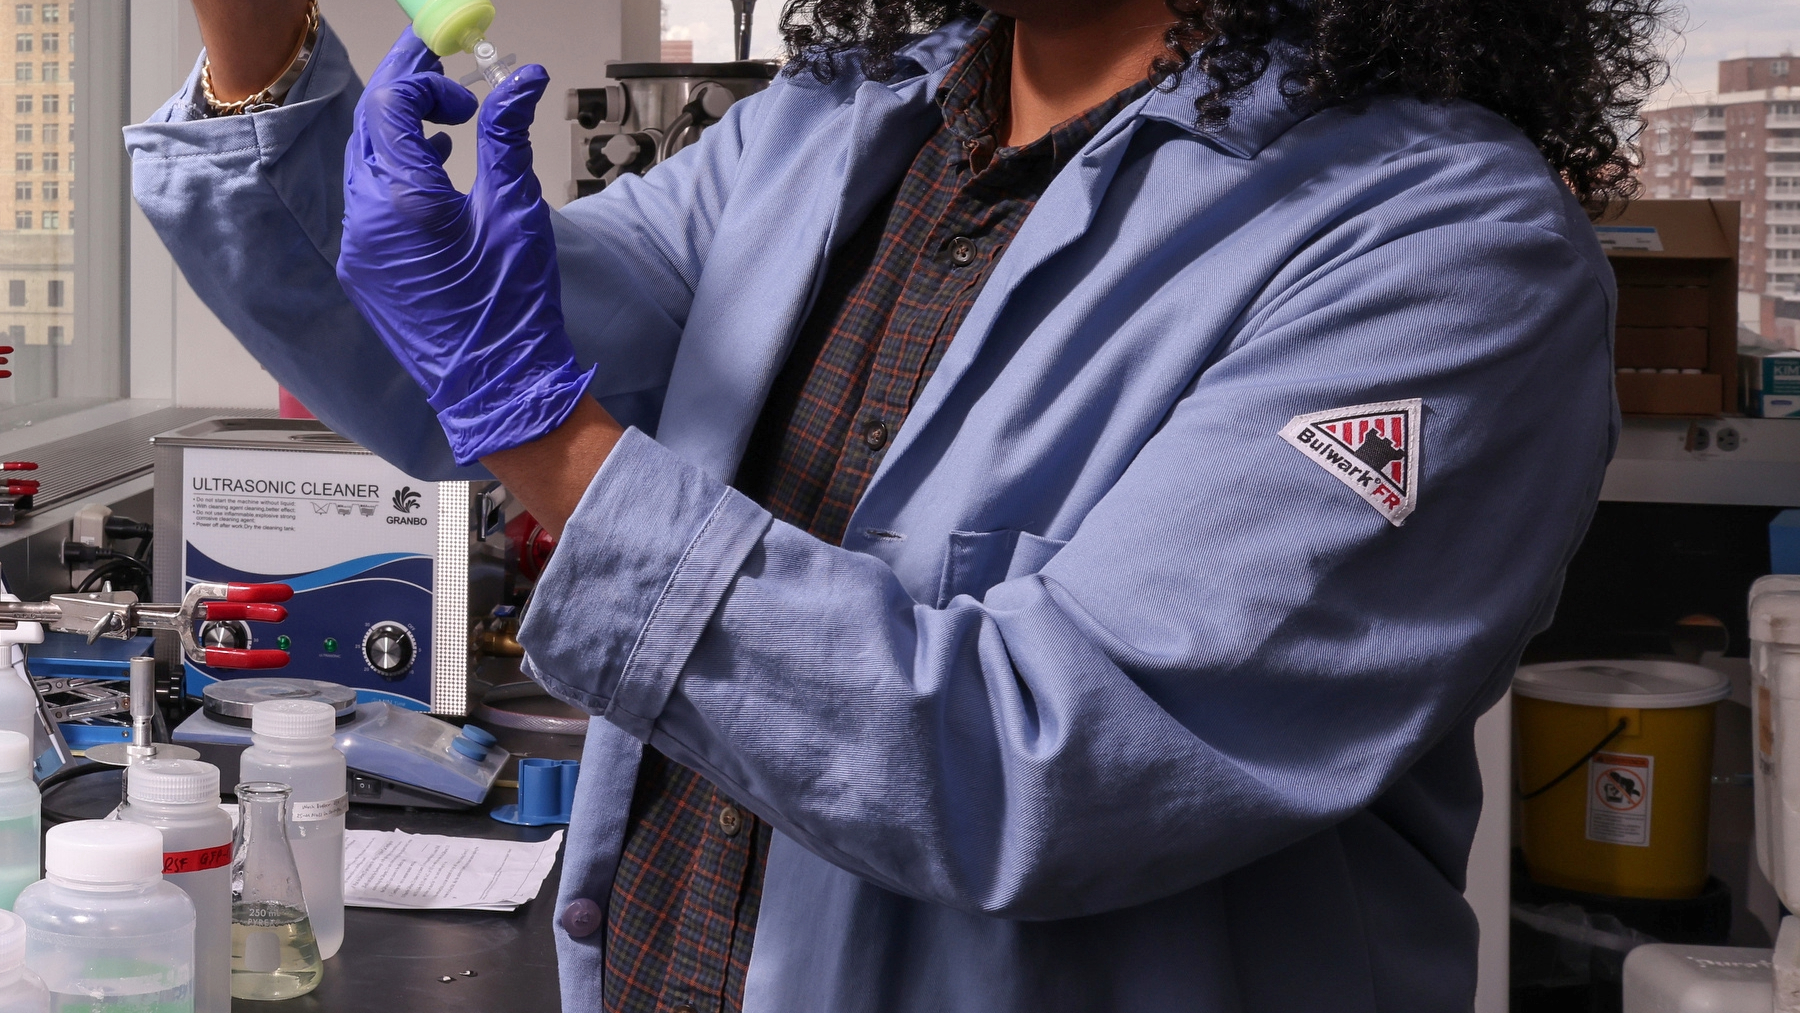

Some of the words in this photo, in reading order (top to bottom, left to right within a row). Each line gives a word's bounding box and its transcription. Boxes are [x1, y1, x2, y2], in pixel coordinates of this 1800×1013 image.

[1774, 366, 1800, 375] KIM
[193, 477, 296, 495] ULTRASONIC
[301, 482, 379, 498] CLEANER
[1372, 484, 1401, 510] FR
[386, 516, 428, 526] GRANBO
[407, 623, 416, 631] OFF
[249, 909, 266, 917] 250
